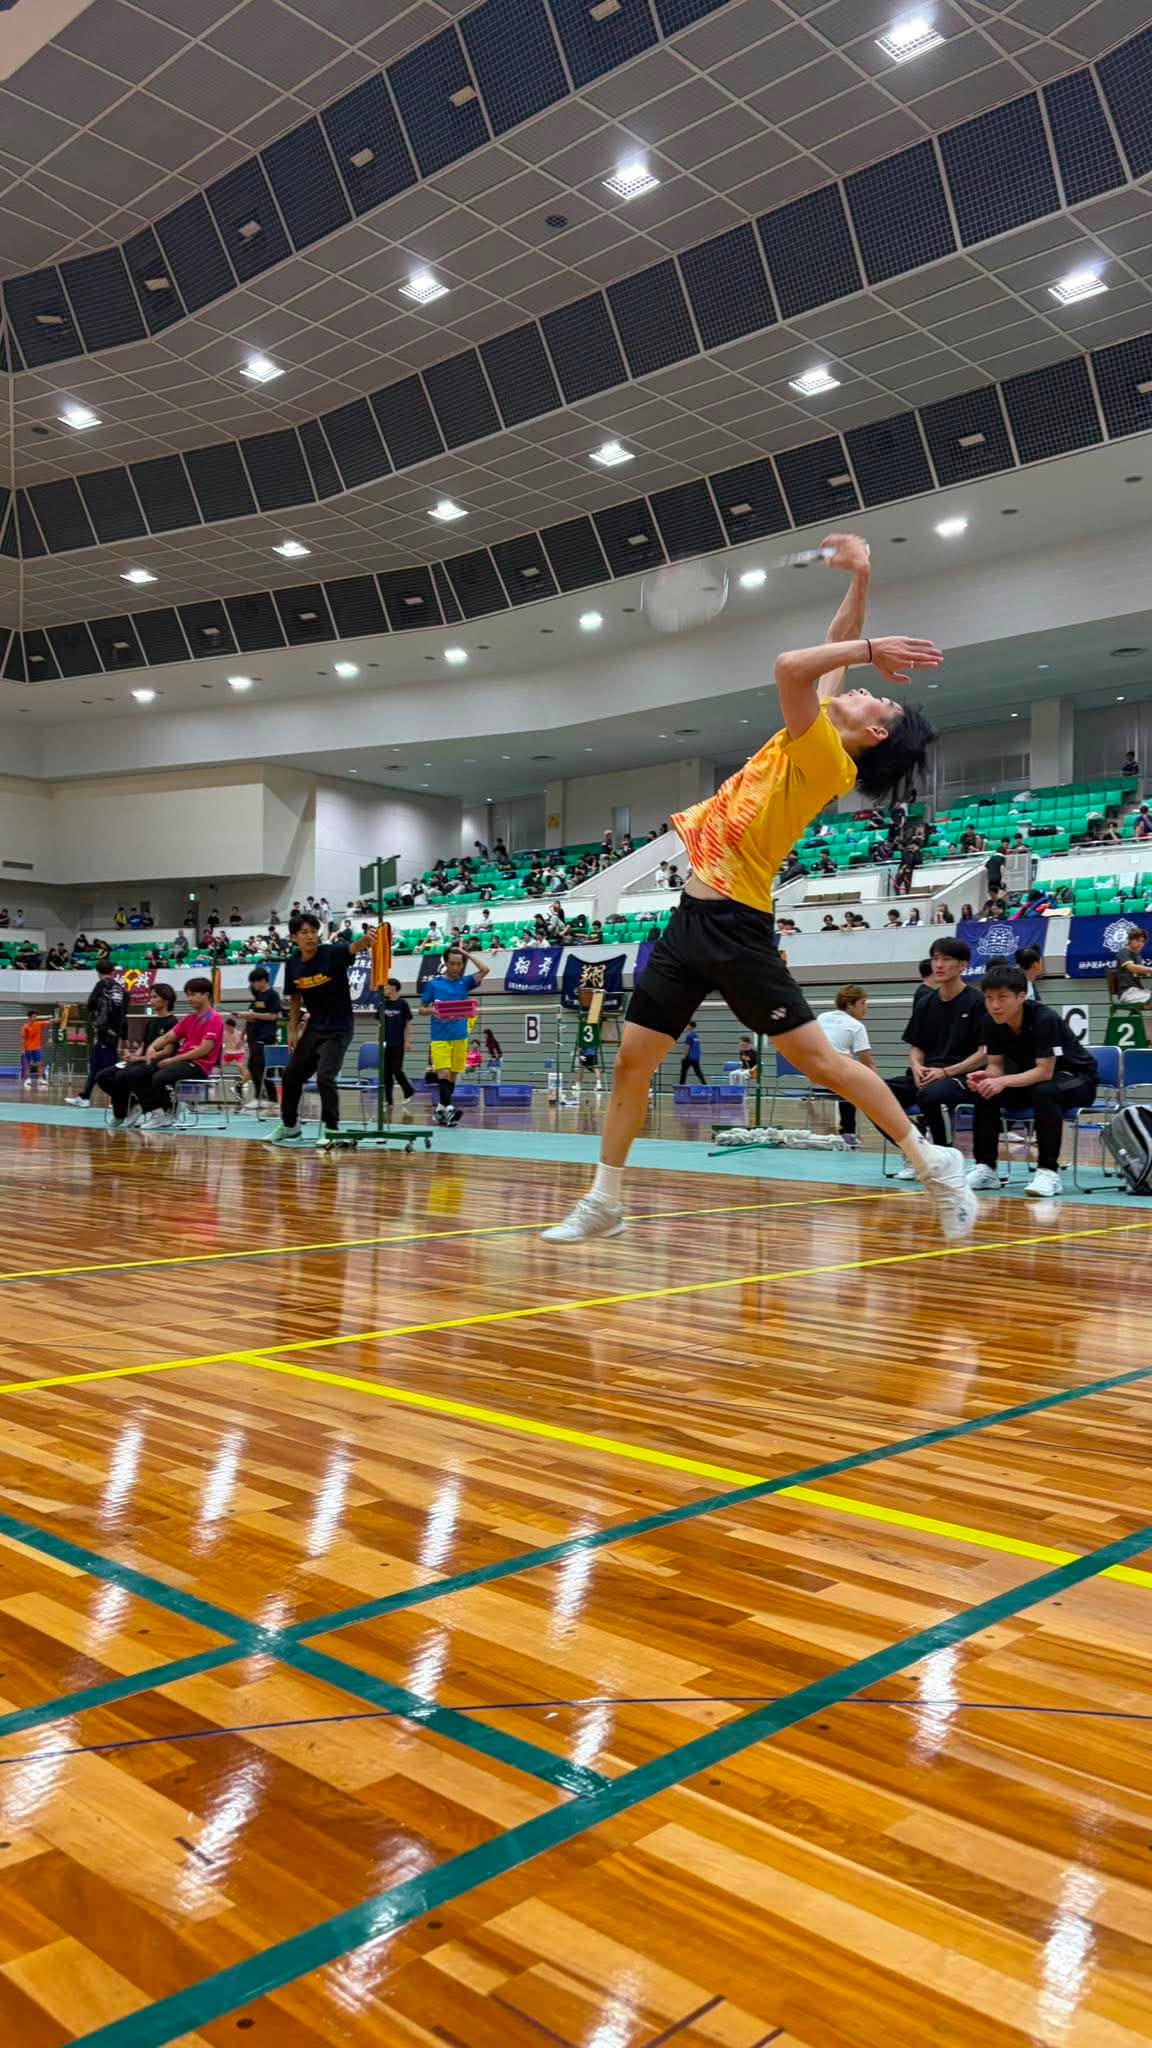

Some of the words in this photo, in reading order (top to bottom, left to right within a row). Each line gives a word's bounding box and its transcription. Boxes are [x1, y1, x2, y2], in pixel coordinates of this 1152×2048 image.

[527, 1016, 538, 1041] B
[583, 1026, 594, 1042] 3
[1065, 1008, 1087, 1041] C
[1117, 1023, 1136, 1047] 2
